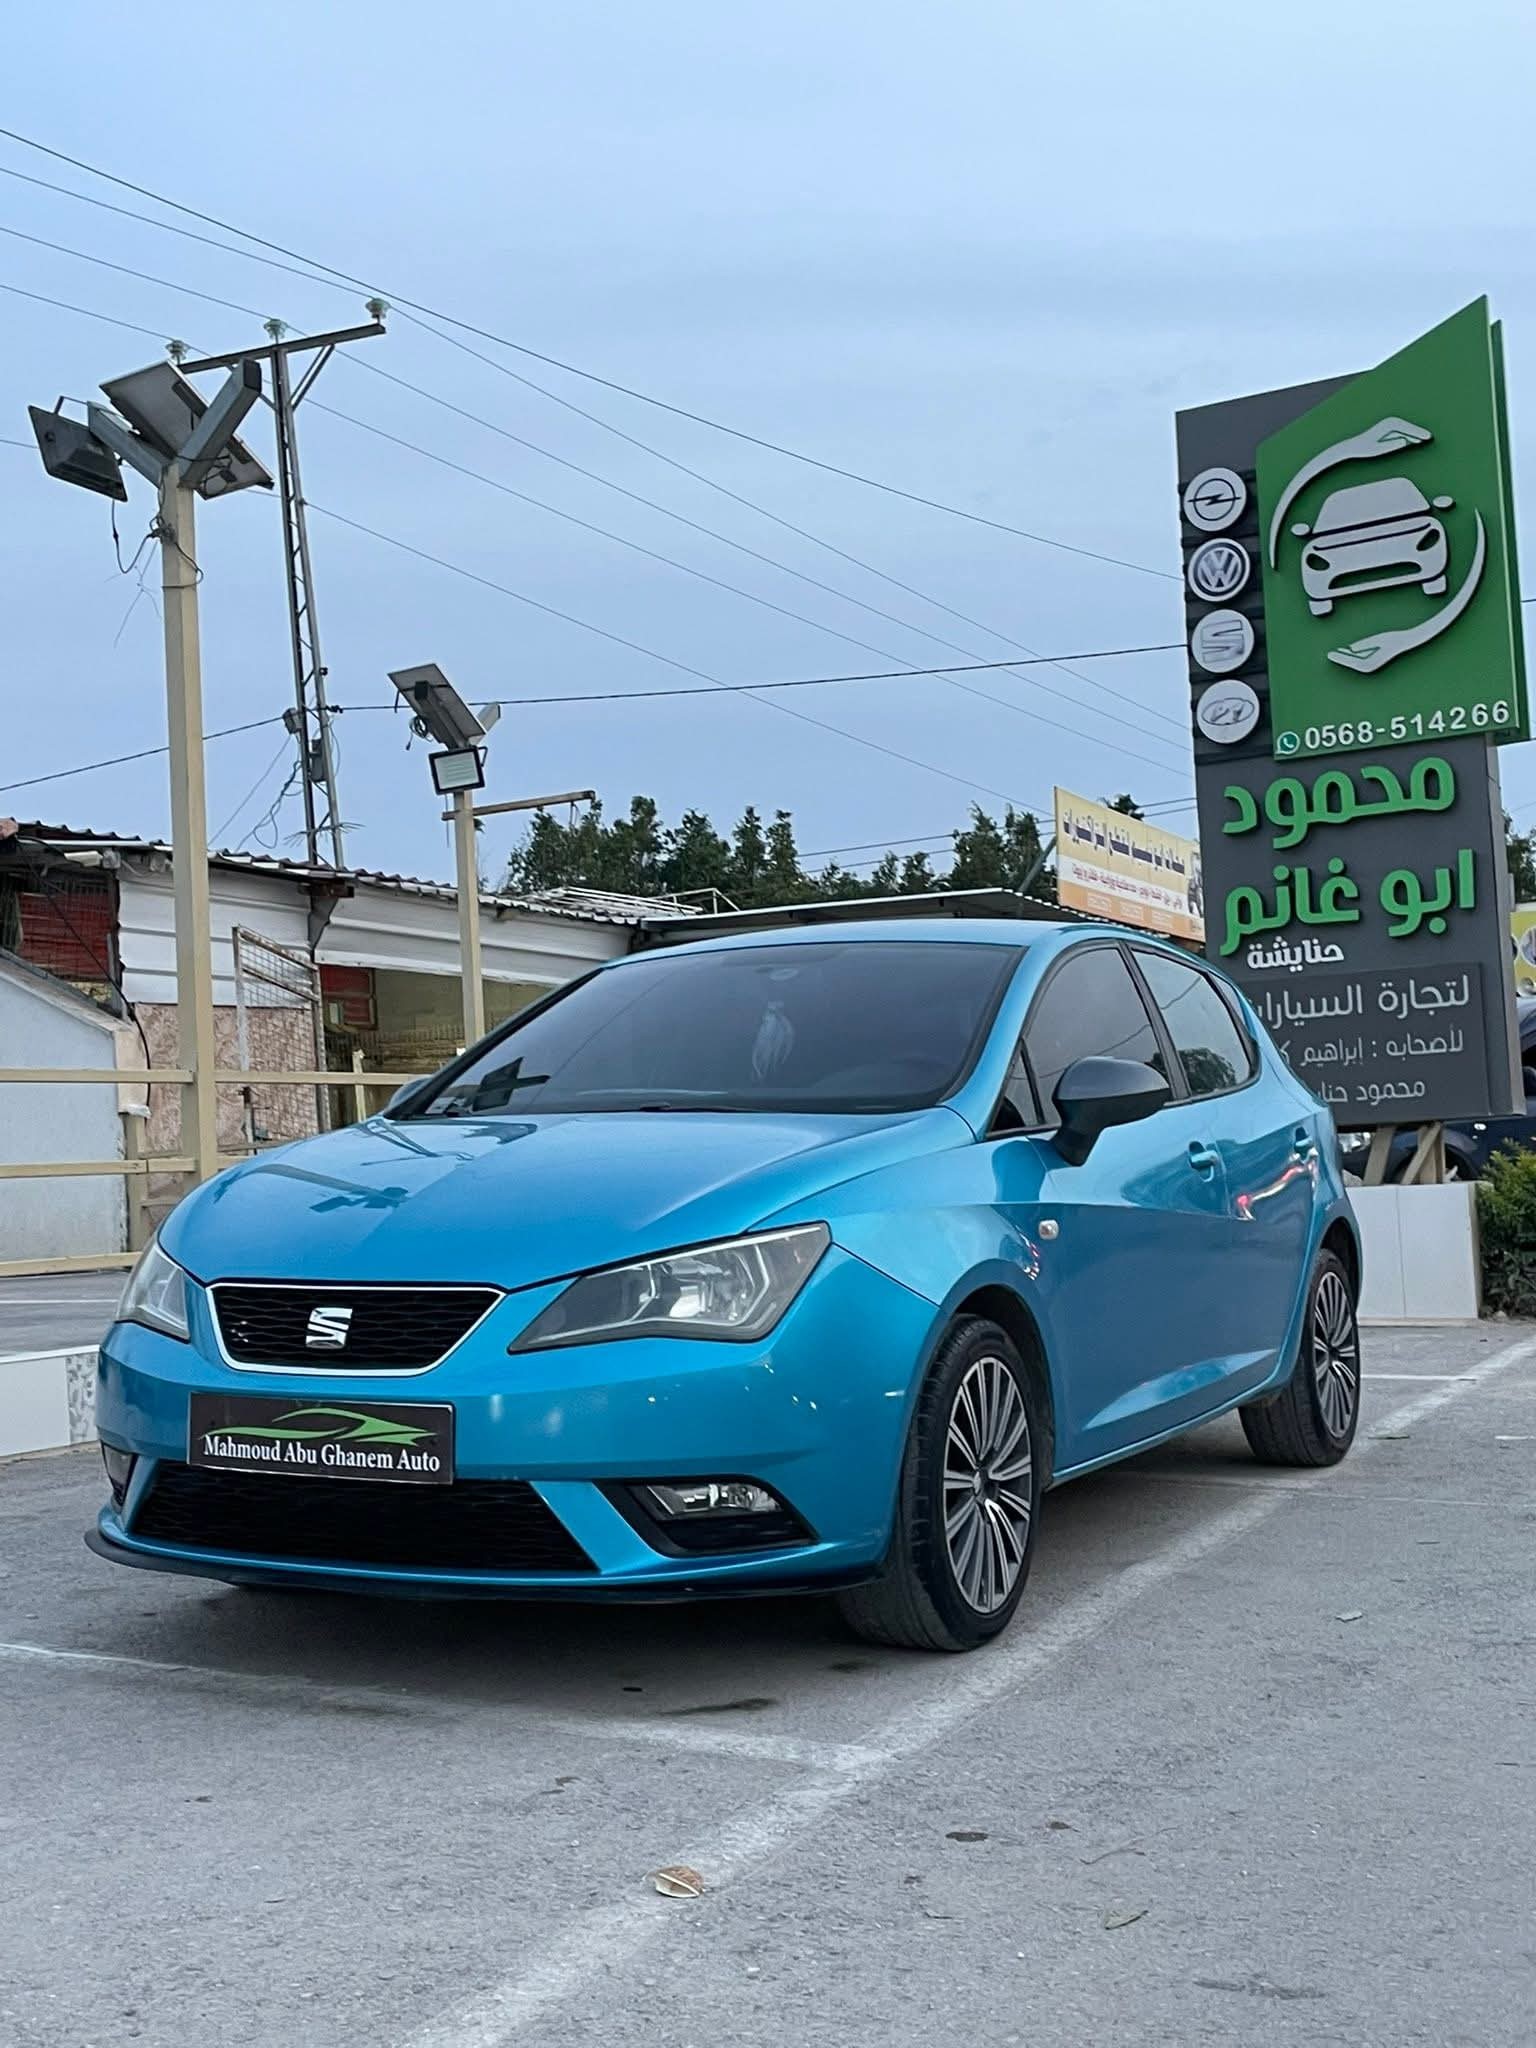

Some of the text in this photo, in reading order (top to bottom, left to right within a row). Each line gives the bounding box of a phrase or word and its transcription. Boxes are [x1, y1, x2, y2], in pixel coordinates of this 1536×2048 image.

[1304, 699, 1510, 750] 0568-514266
[1221, 756, 1456, 850] محمود
[1219, 857, 1360, 956] غانم
[1379, 848, 1475, 937] ابو
[1246, 935, 1345, 973] حنايشة
[1256, 974, 1470, 1030] لتجارة السيارا
[1355, 1080, 1426, 1106] محمود
[203, 1433, 441, 1472] Mahmoud Abu Ghanem Auto
